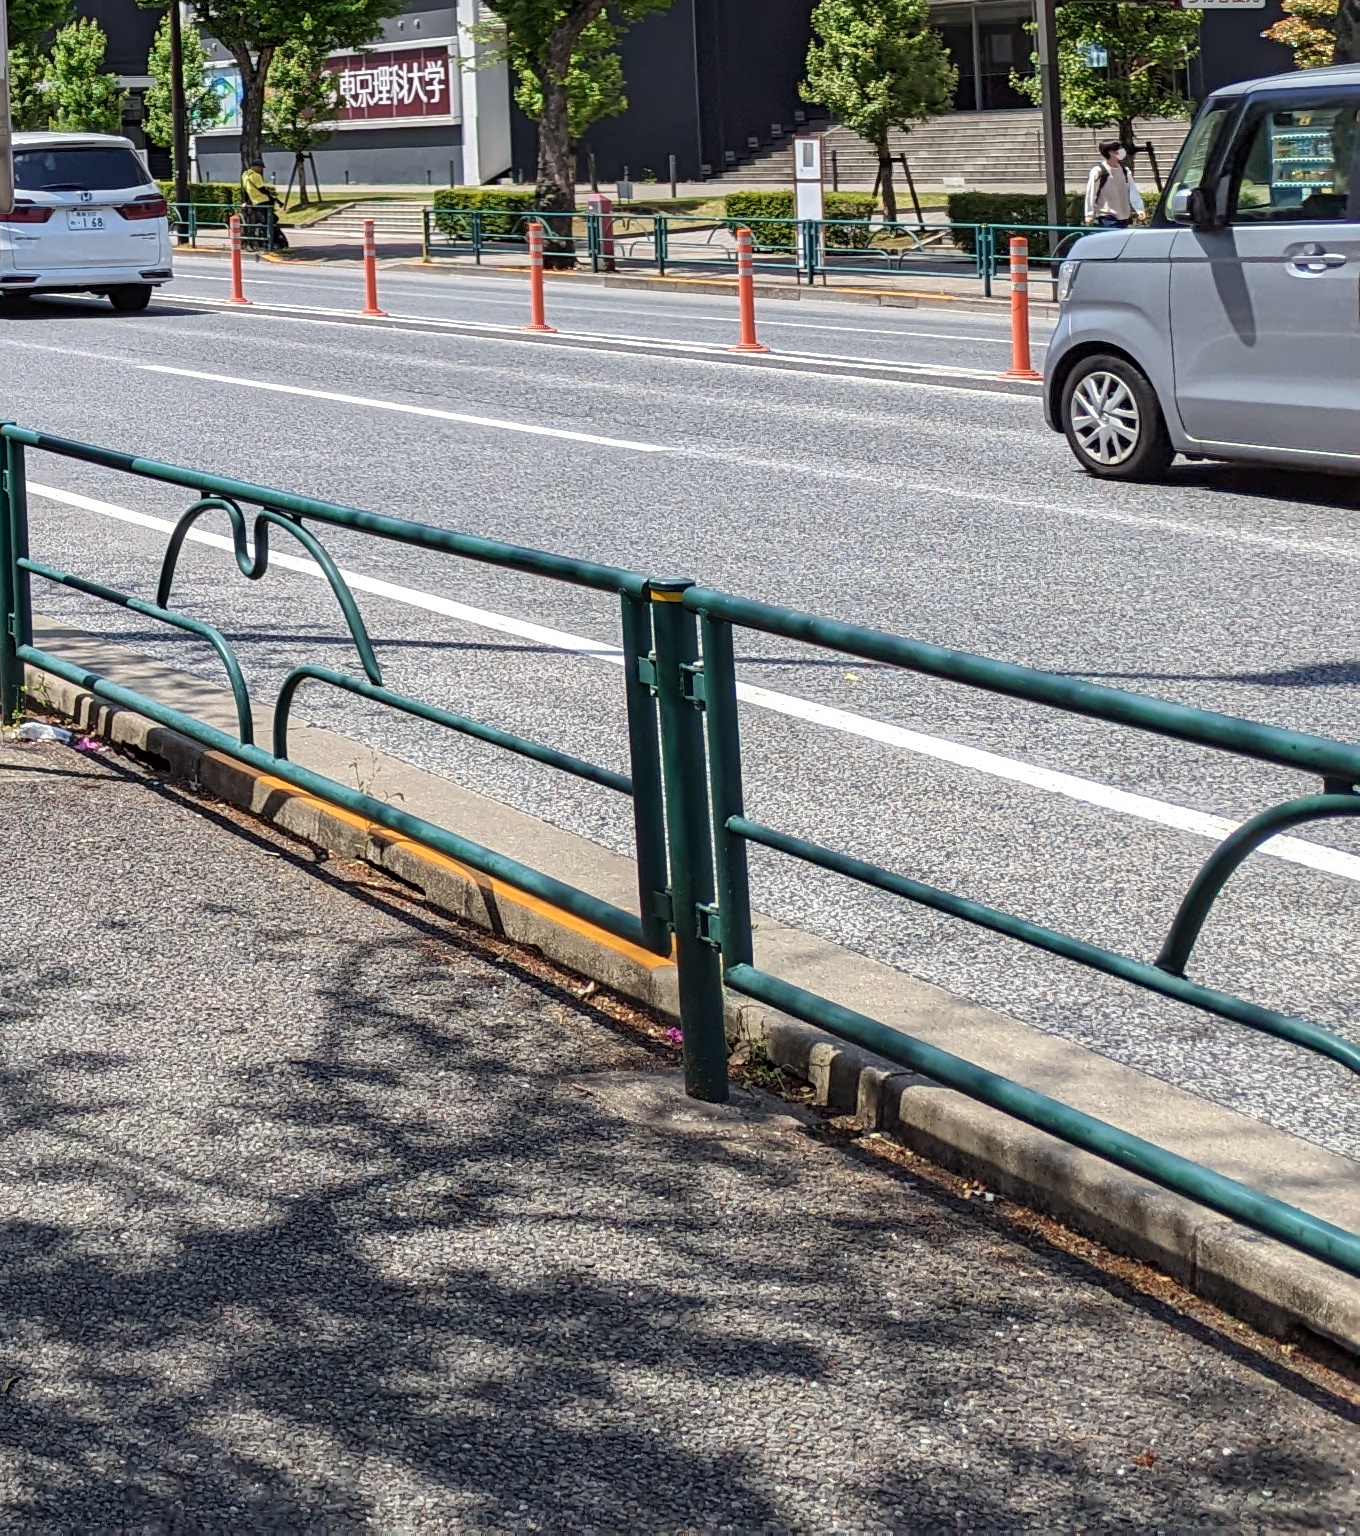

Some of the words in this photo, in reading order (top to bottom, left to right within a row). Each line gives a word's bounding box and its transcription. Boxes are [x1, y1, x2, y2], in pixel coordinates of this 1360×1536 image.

[338, 60, 445, 108] 東京理科大学
